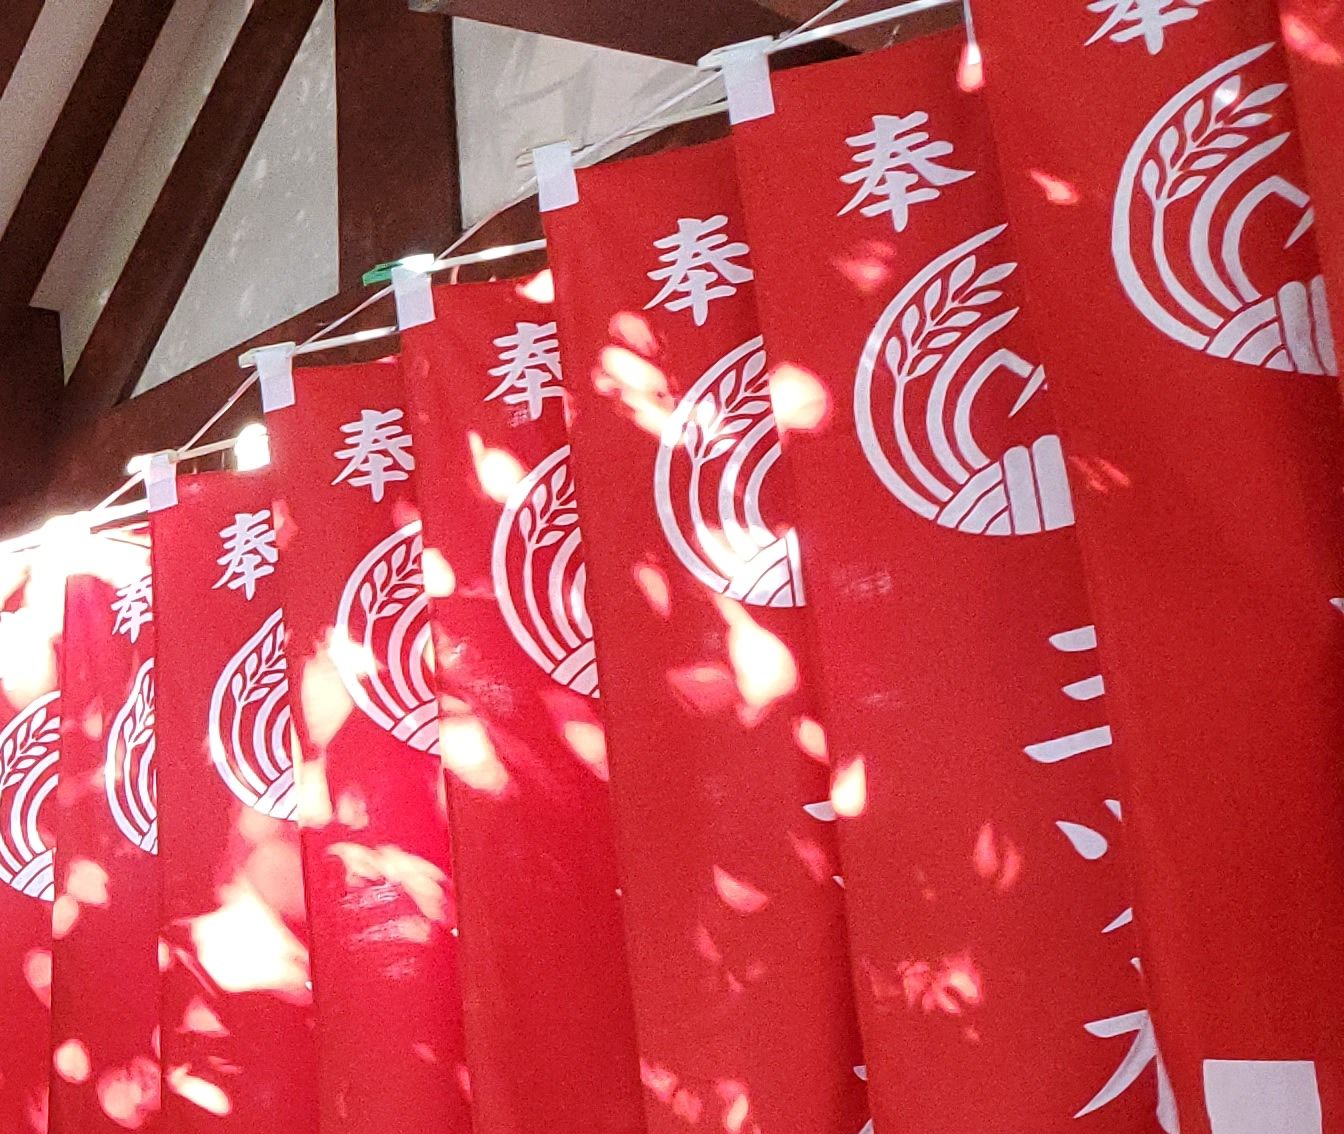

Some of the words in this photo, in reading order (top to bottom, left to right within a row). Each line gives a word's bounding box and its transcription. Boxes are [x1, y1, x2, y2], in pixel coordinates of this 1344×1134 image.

[837, 110, 976, 232] 奉
[643, 214, 755, 326] 奉
[332, 408, 416, 502] 奉
